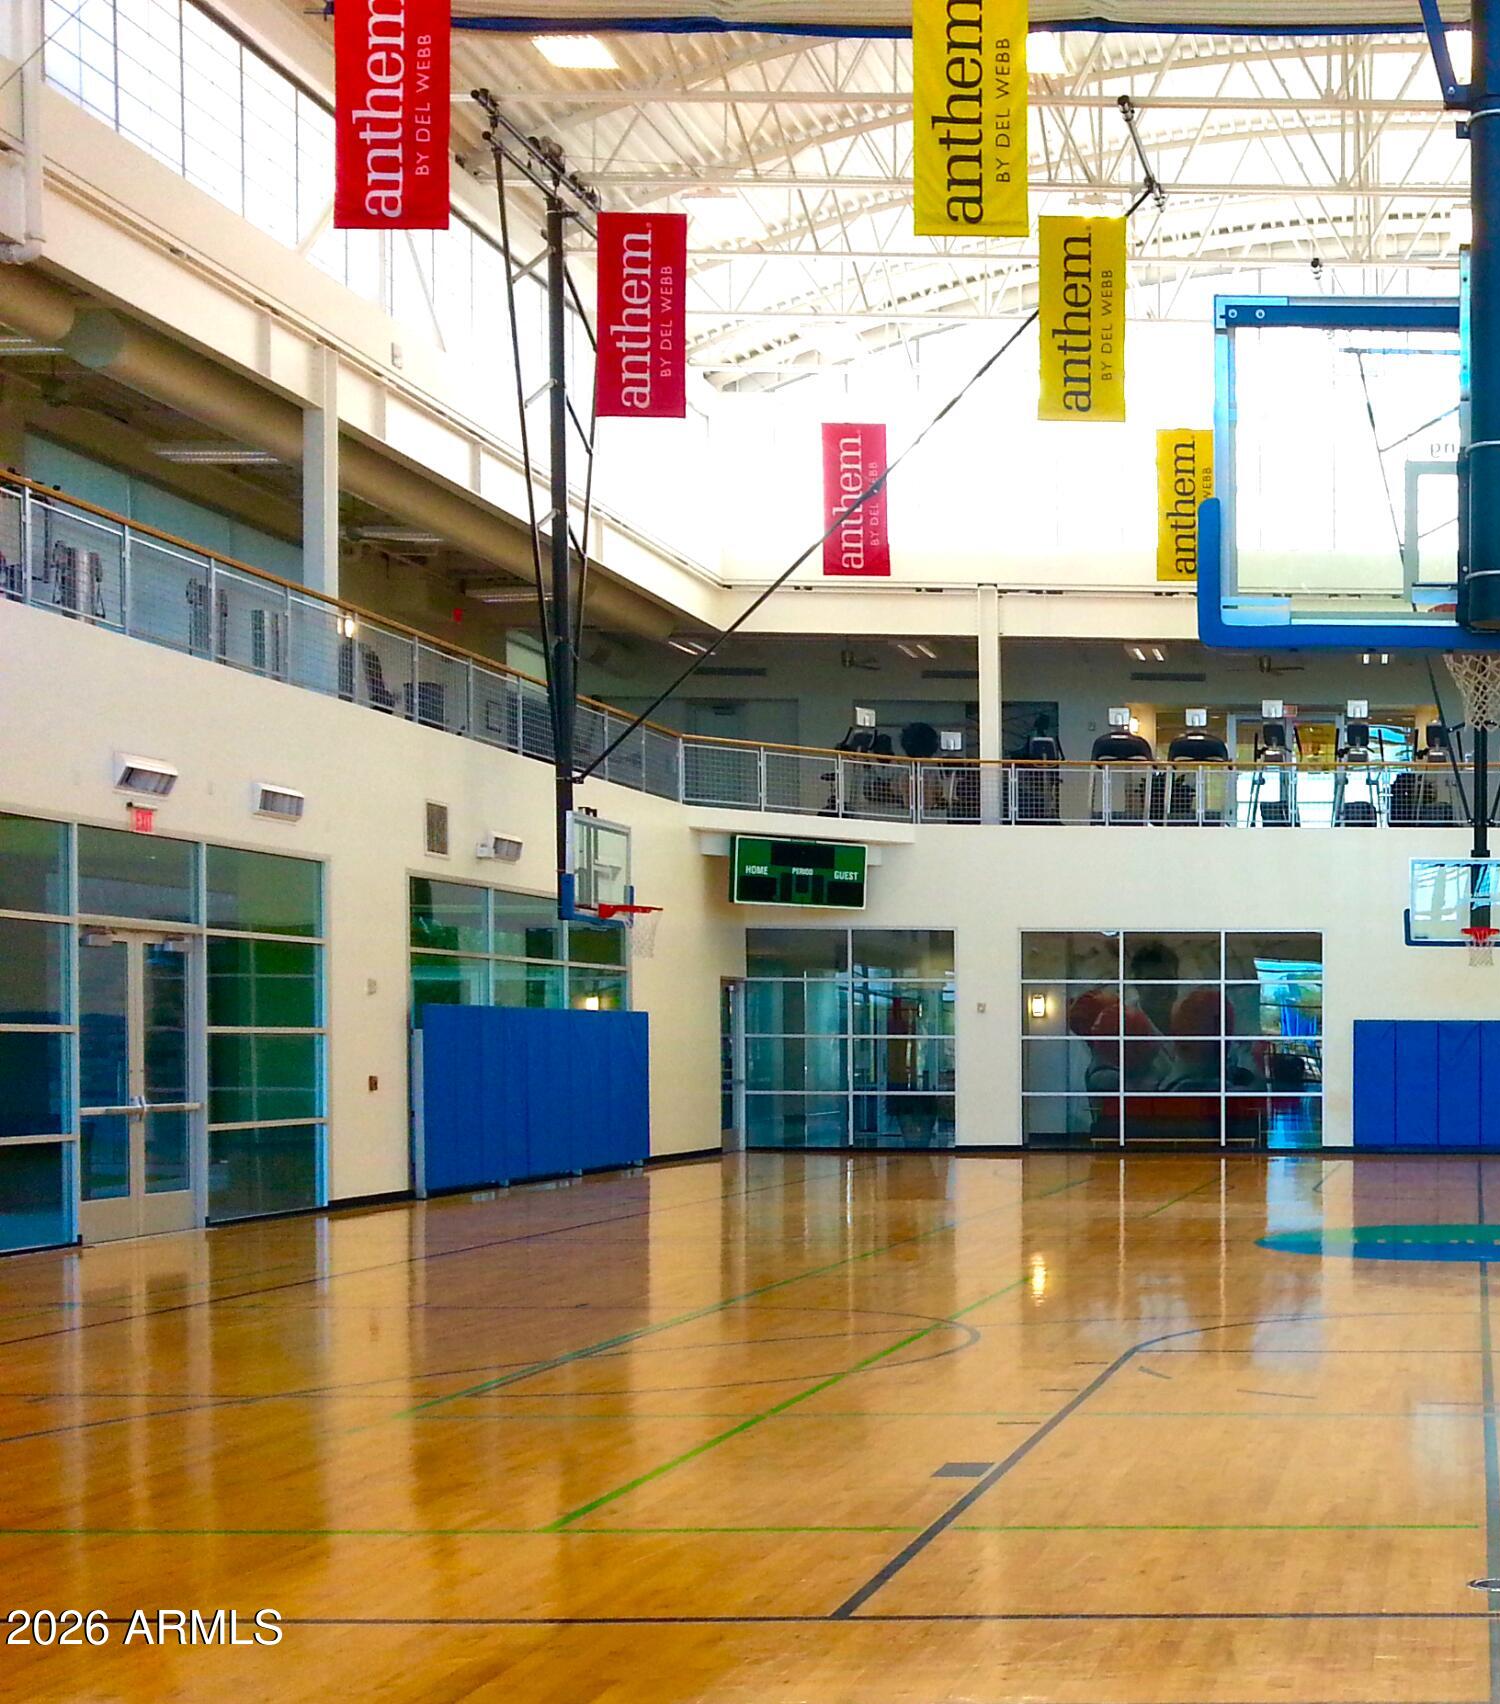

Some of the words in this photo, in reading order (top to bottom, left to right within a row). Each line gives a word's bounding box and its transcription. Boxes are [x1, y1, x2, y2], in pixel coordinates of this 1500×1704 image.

[416, 34, 432, 93] WEBB
[996, 38, 1010, 99] WEBB
[352, 0, 404, 218] anthem
[415, 102, 431, 142] DEL
[931, 0, 984, 225] anthem
[996, 113, 1010, 148] DEL
[415, 154, 430, 176] BY
[996, 159, 1010, 183] BY
[660, 265, 673, 312] WEBB
[1101, 270, 1113, 316] WEBB
[610, 229, 651, 409] anthem
[660, 321, 673, 350] DEL
[1052, 232, 1092, 412] anthem
[1101, 325, 1113, 354] DEL
[660, 359, 671, 377] BY
[1101, 362, 1112, 381] BY
[869, 503, 880, 527] DEL
[1166, 439, 1197, 574] anthem
[870, 531, 880, 546] BY
[745, 865, 769, 876] HOME
[791, 867, 814, 876] PERIOD
[833, 870, 860, 881] GUEST
